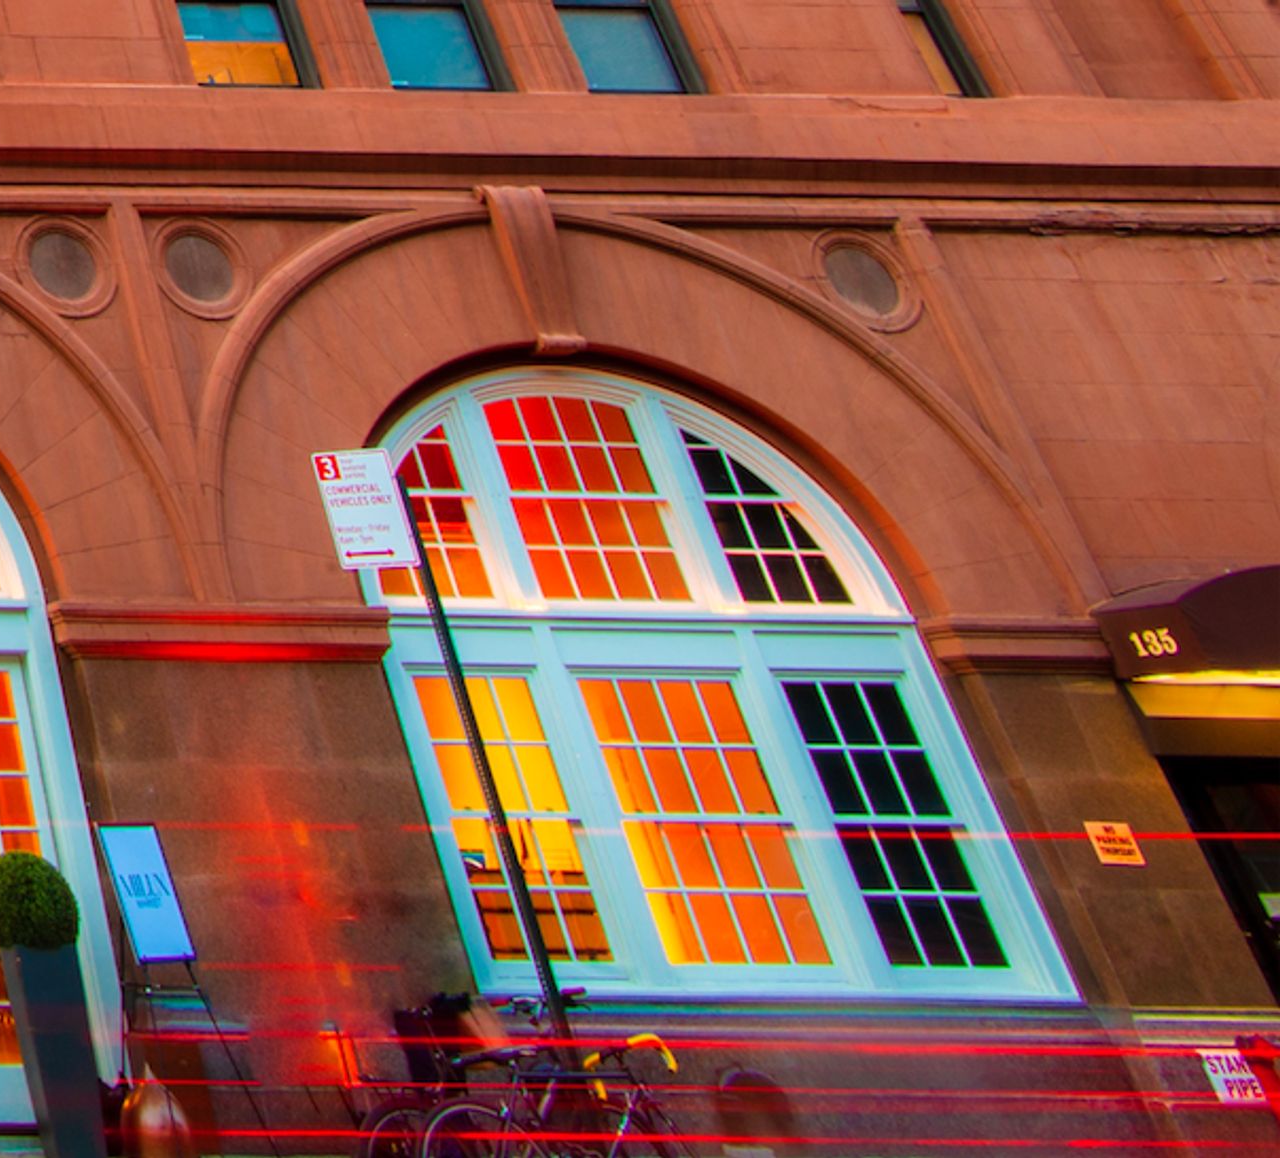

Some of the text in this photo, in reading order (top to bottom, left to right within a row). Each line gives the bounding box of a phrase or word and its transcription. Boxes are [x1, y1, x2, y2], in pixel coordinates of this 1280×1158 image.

[320, 457, 335, 479] 3
[325, 484, 381, 495] COMMERCIAL
[329, 495, 393, 508] VEHICLES ONLY
[1128, 627, 1179, 657] 135
[1205, 1055, 1248, 1074] STAN
[1223, 1078, 1263, 1099] PIPE
